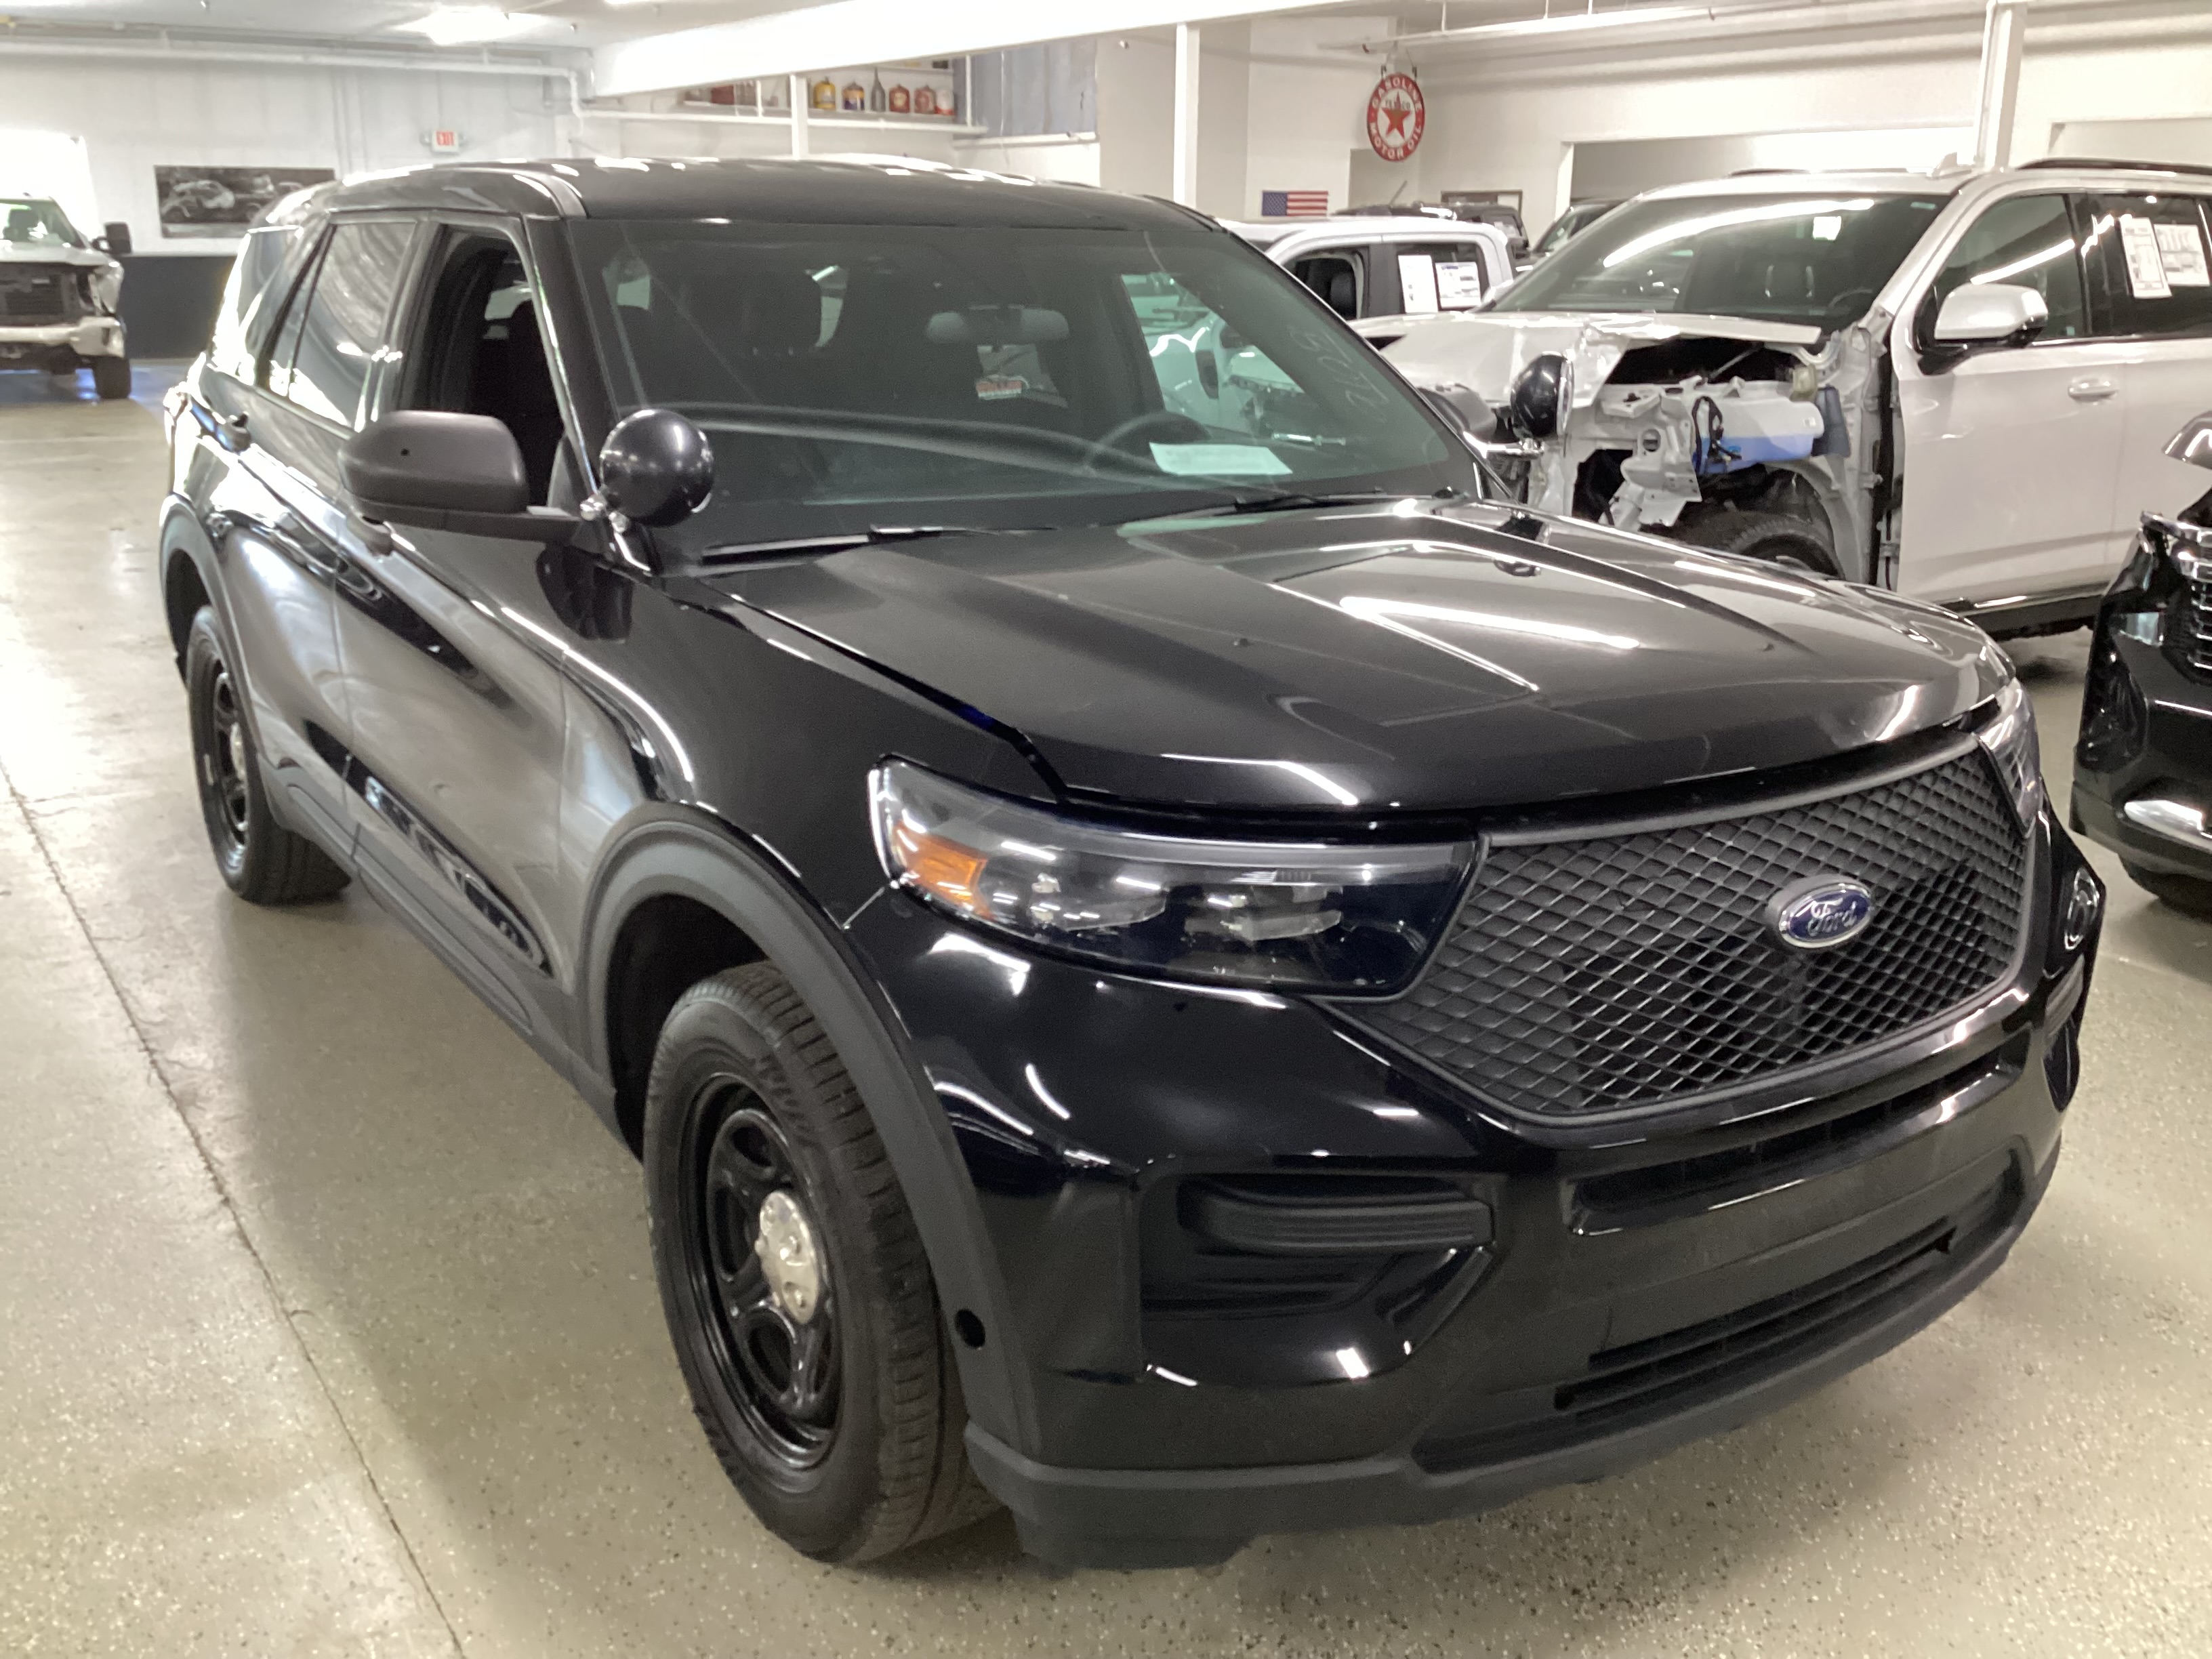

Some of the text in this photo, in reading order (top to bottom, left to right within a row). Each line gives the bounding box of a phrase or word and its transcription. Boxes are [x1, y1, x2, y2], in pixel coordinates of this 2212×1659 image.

[1372, 77, 1422, 110] GASOLINE
[1370, 122, 1421, 160] MOTOR OIL
[1807, 897, 1857, 937] Ford
